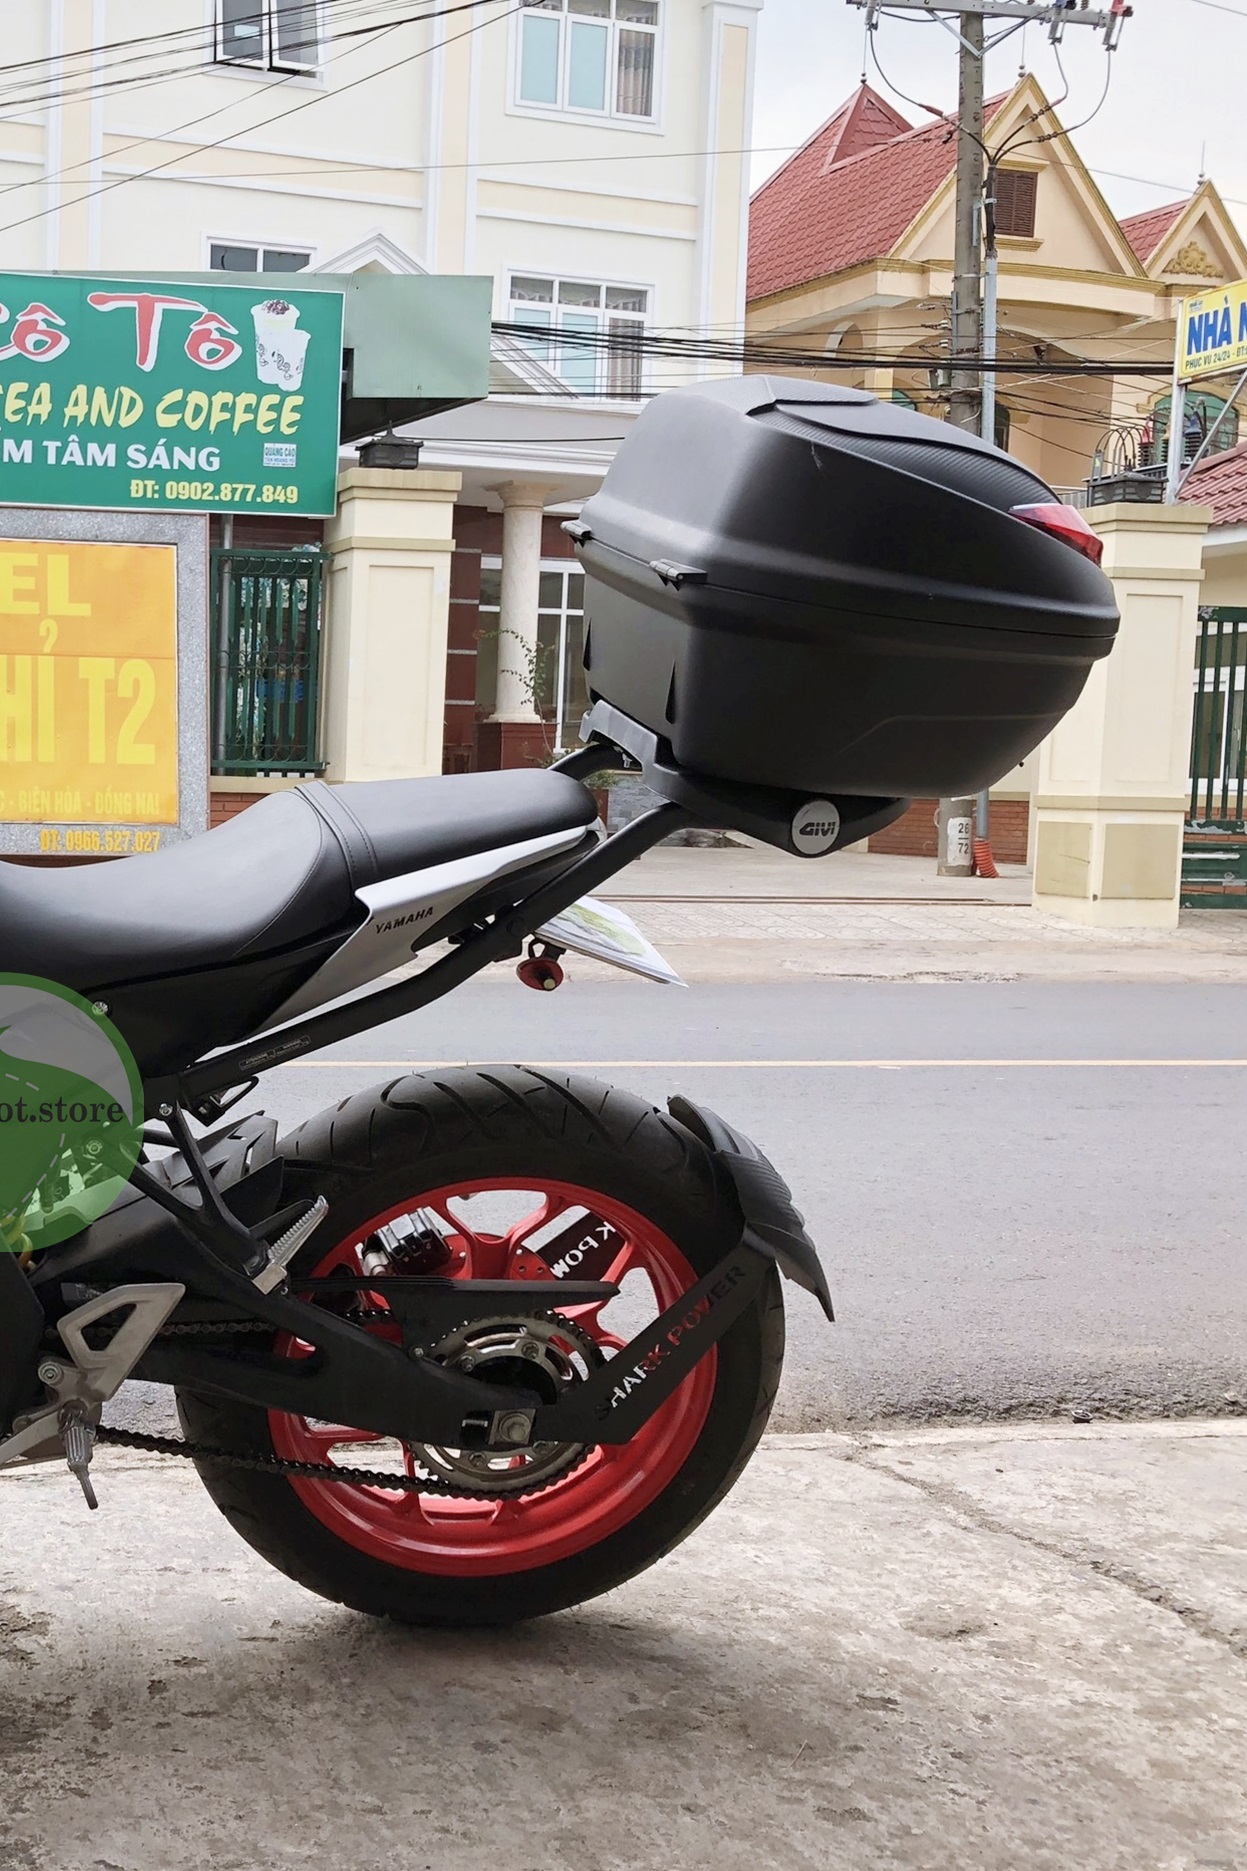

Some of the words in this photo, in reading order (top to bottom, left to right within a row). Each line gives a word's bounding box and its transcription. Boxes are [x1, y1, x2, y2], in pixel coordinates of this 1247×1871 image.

[87, 292, 242, 372] Tô
[1187, 295, 1232, 356] NHÀ
[63, 385, 144, 430] AND
[155, 388, 304, 436] COFFEE
[42, 434, 116, 467] TÂM
[126, 438, 220, 472] SÁNG
[130, 479, 159, 498] ĐT:
[165, 480, 298, 504] 0902.877.849
[78, 657, 156, 766] T2
[18, 785, 51, 814] BIÊN
[54, 785, 82, 814] HÒA
[136, 792, 160, 816] NAI
[65, 830, 160, 852] 0966.527.027
[799, 821, 836, 837] GIVI
[958, 823, 970, 834] 26
[958, 843, 969, 854] 72
[376, 906, 433, 934] YAMAHA
[667, 1265, 747, 1346] POWER
